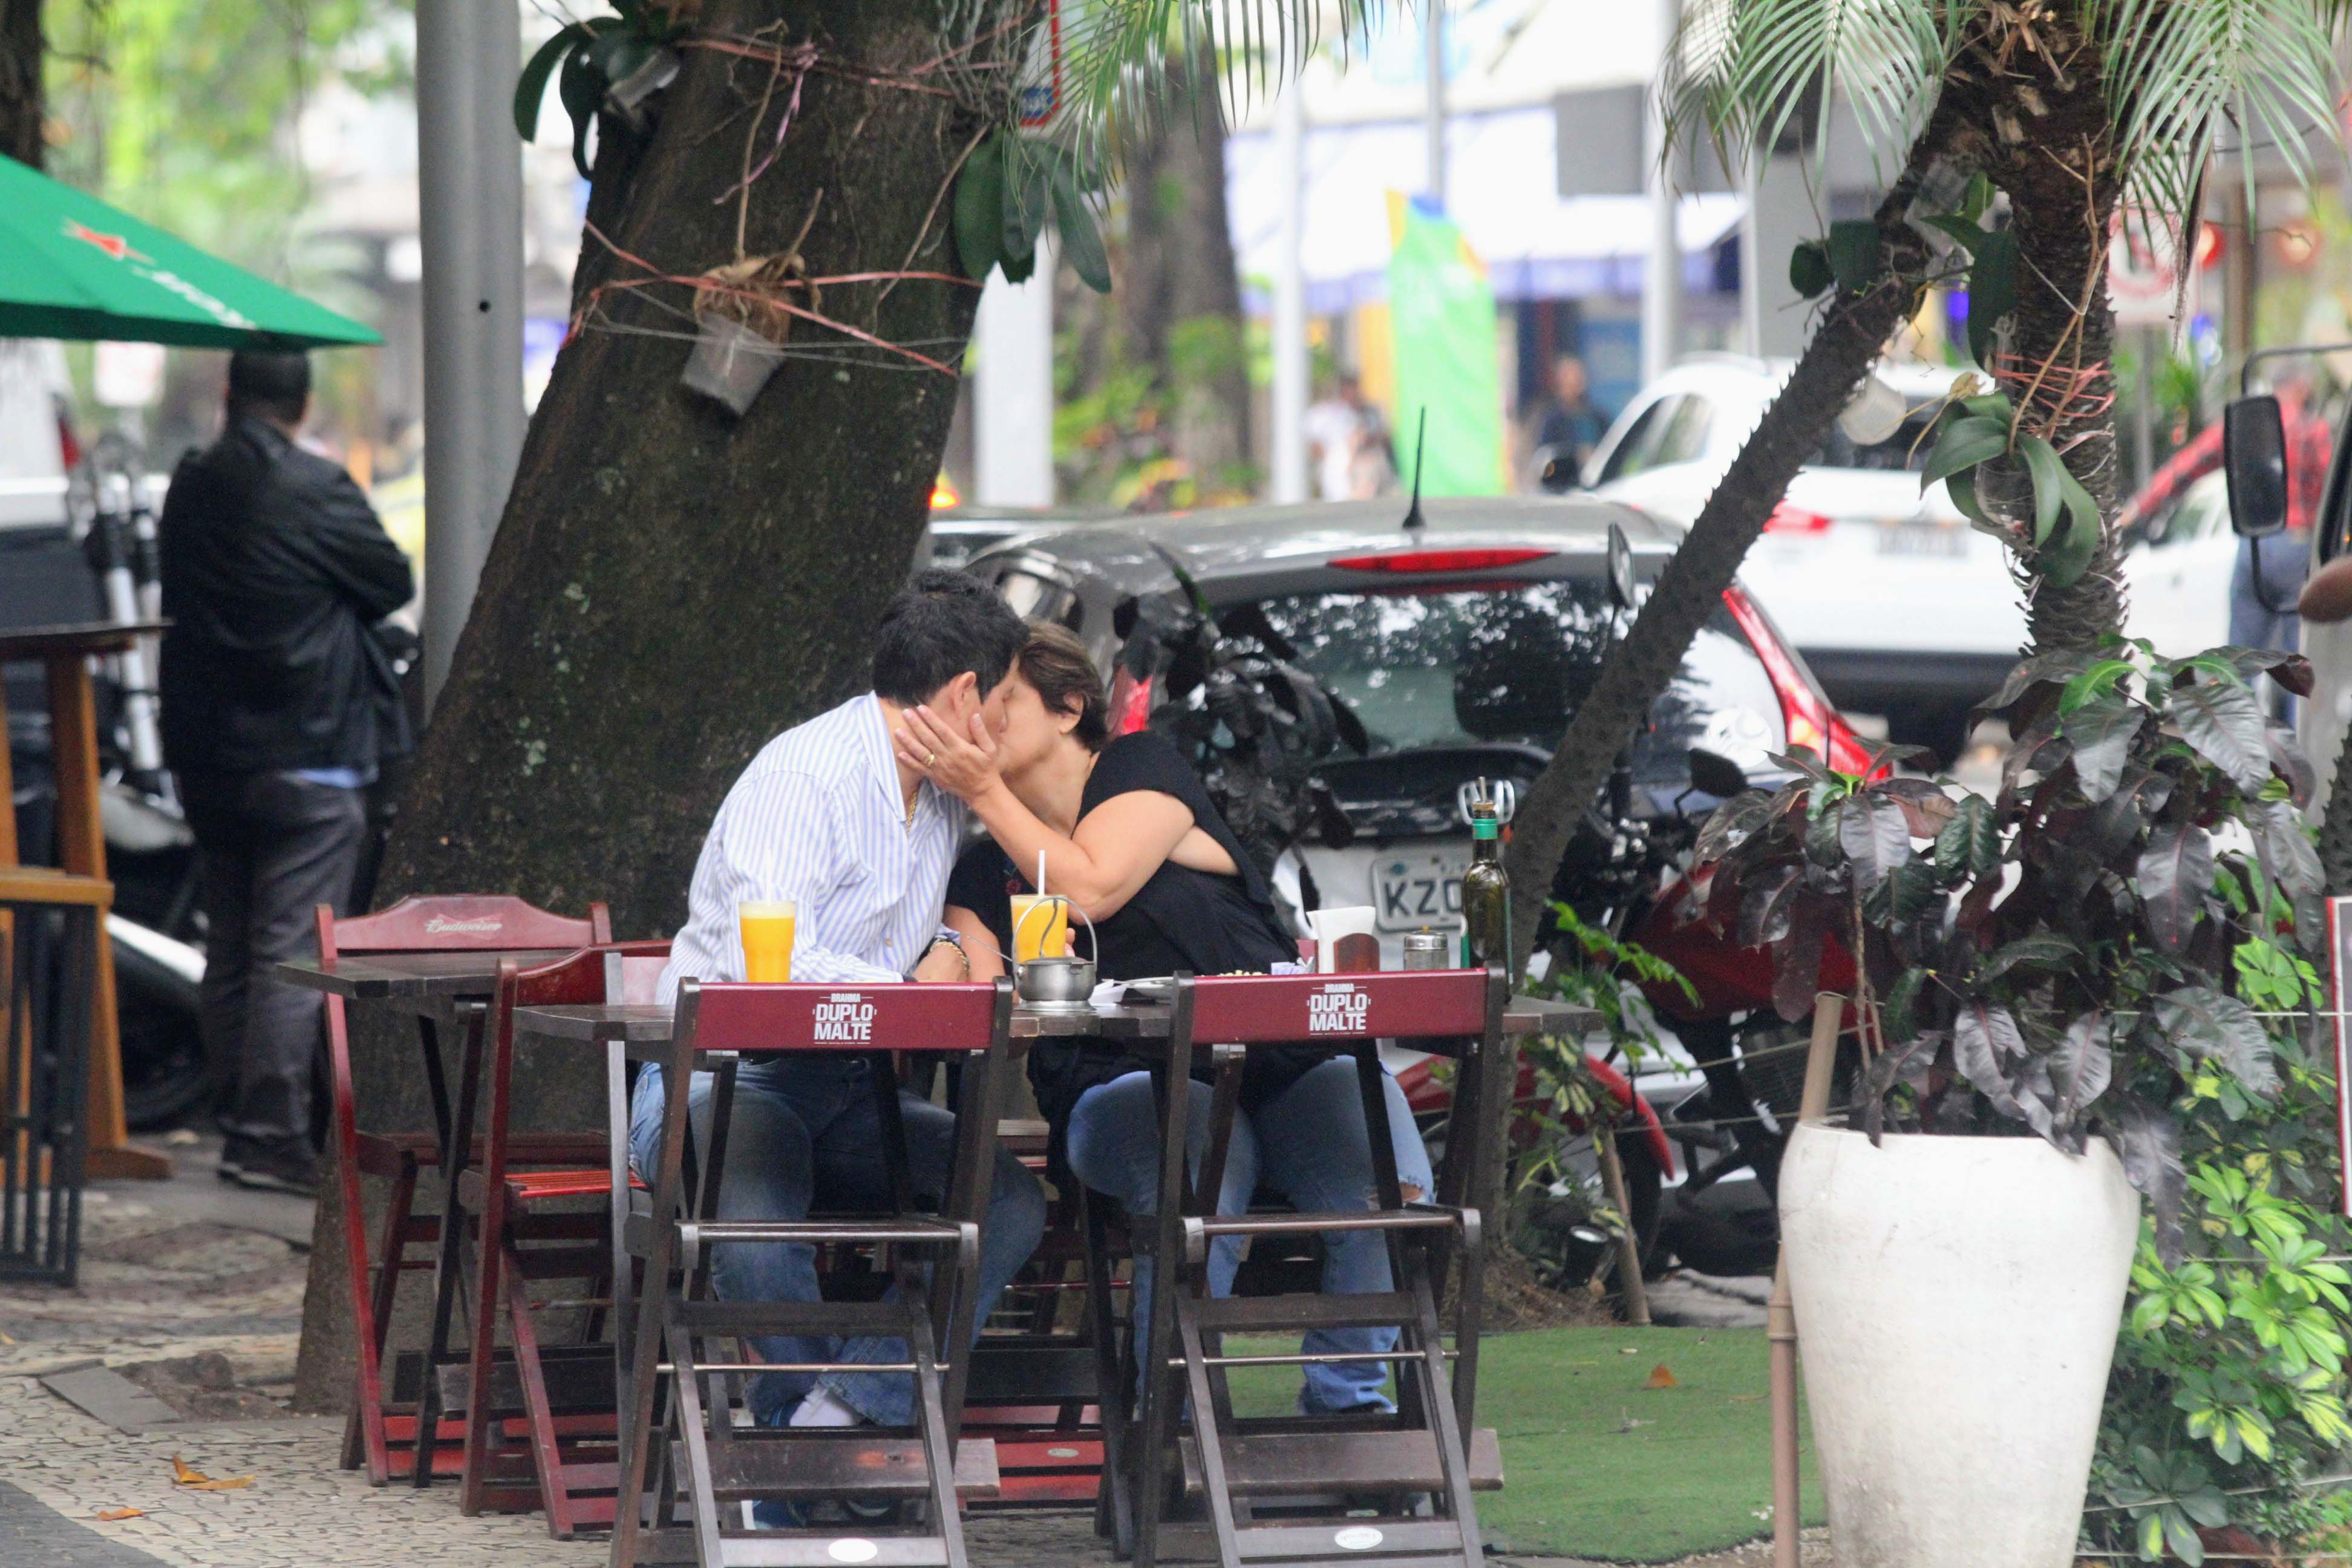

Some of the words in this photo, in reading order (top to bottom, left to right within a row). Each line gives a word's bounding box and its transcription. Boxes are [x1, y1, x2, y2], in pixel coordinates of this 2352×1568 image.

[426, 919, 503, 933] Budweiser
[831, 993, 861, 1003] BRAHMA
[1310, 993, 1368, 1012] DUPLO
[815, 1004, 874, 1022] DUPLO
[1309, 1012, 1367, 1031] MALTE
[814, 1023, 872, 1040] MALTE
